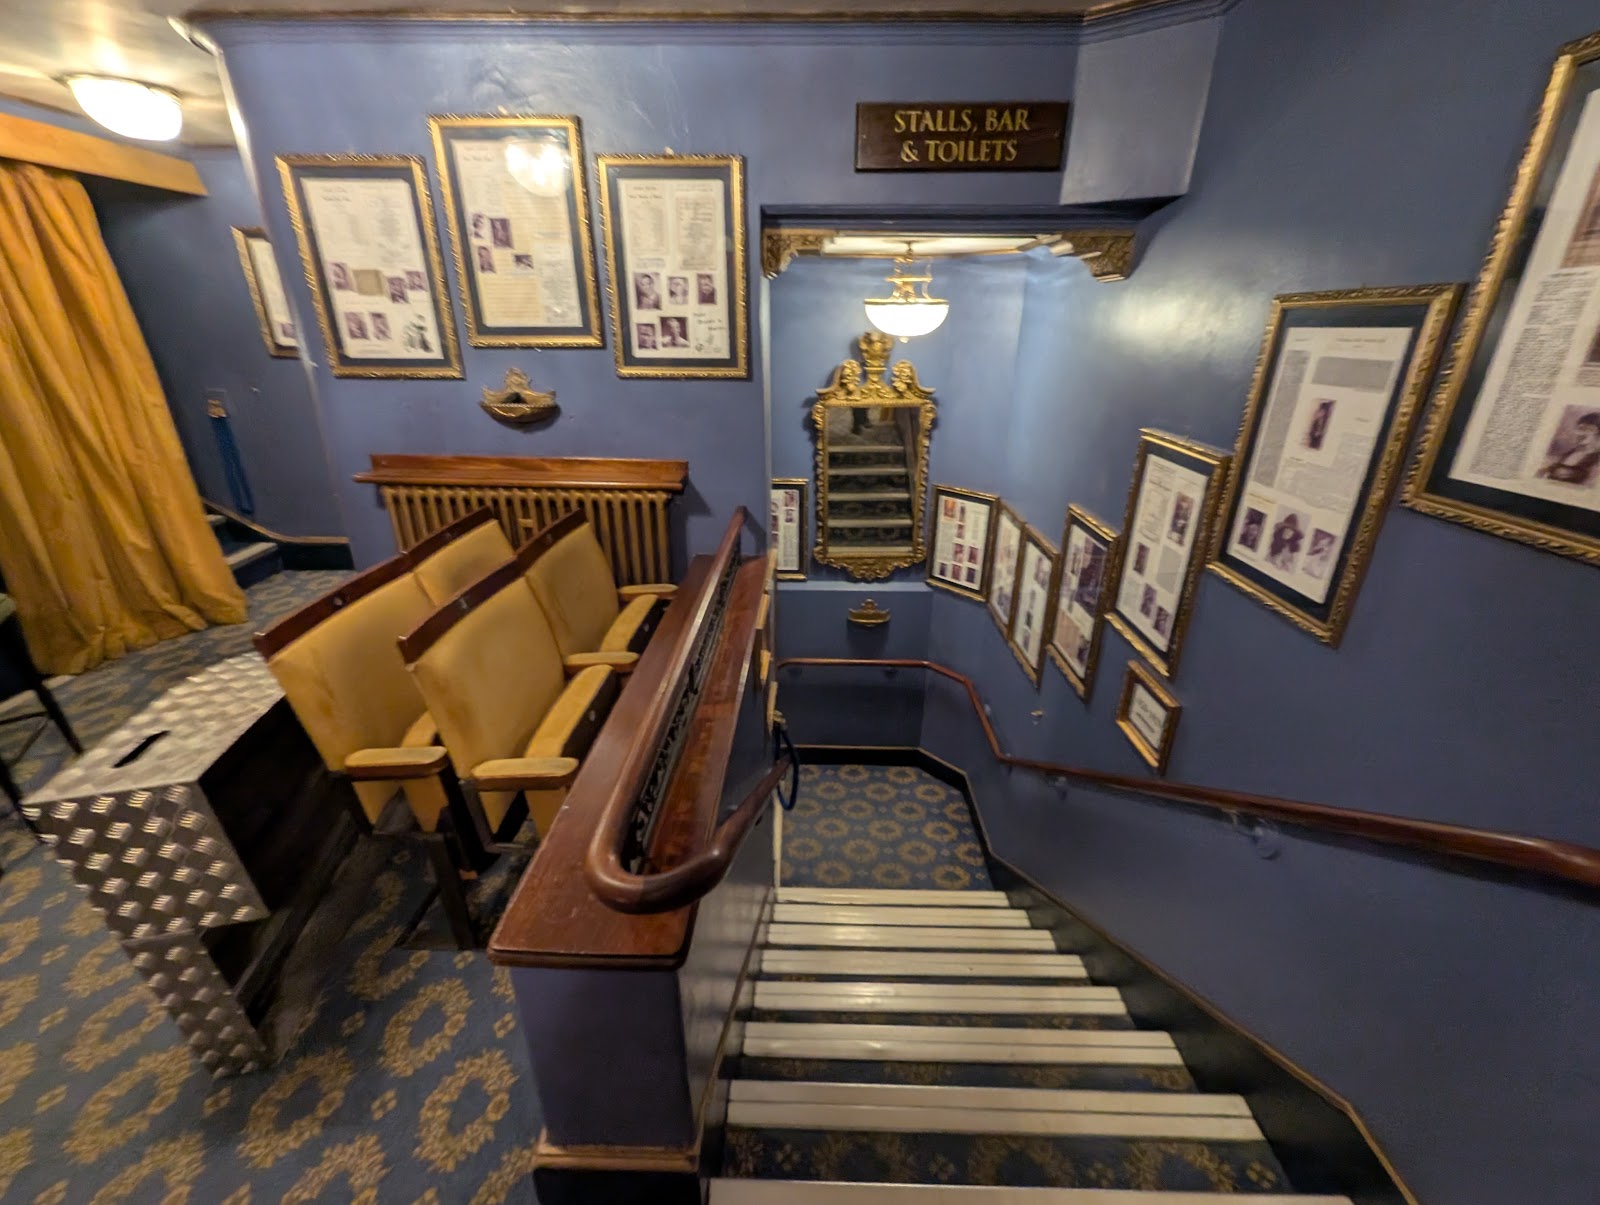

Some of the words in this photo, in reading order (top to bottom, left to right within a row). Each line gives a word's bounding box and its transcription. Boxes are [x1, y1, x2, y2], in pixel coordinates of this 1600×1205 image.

[894, 108, 978, 134] STALLS,
[985, 108, 1031, 132] BAR
[899, 139, 920, 163] &
[925, 139, 1018, 163] TOILETS
